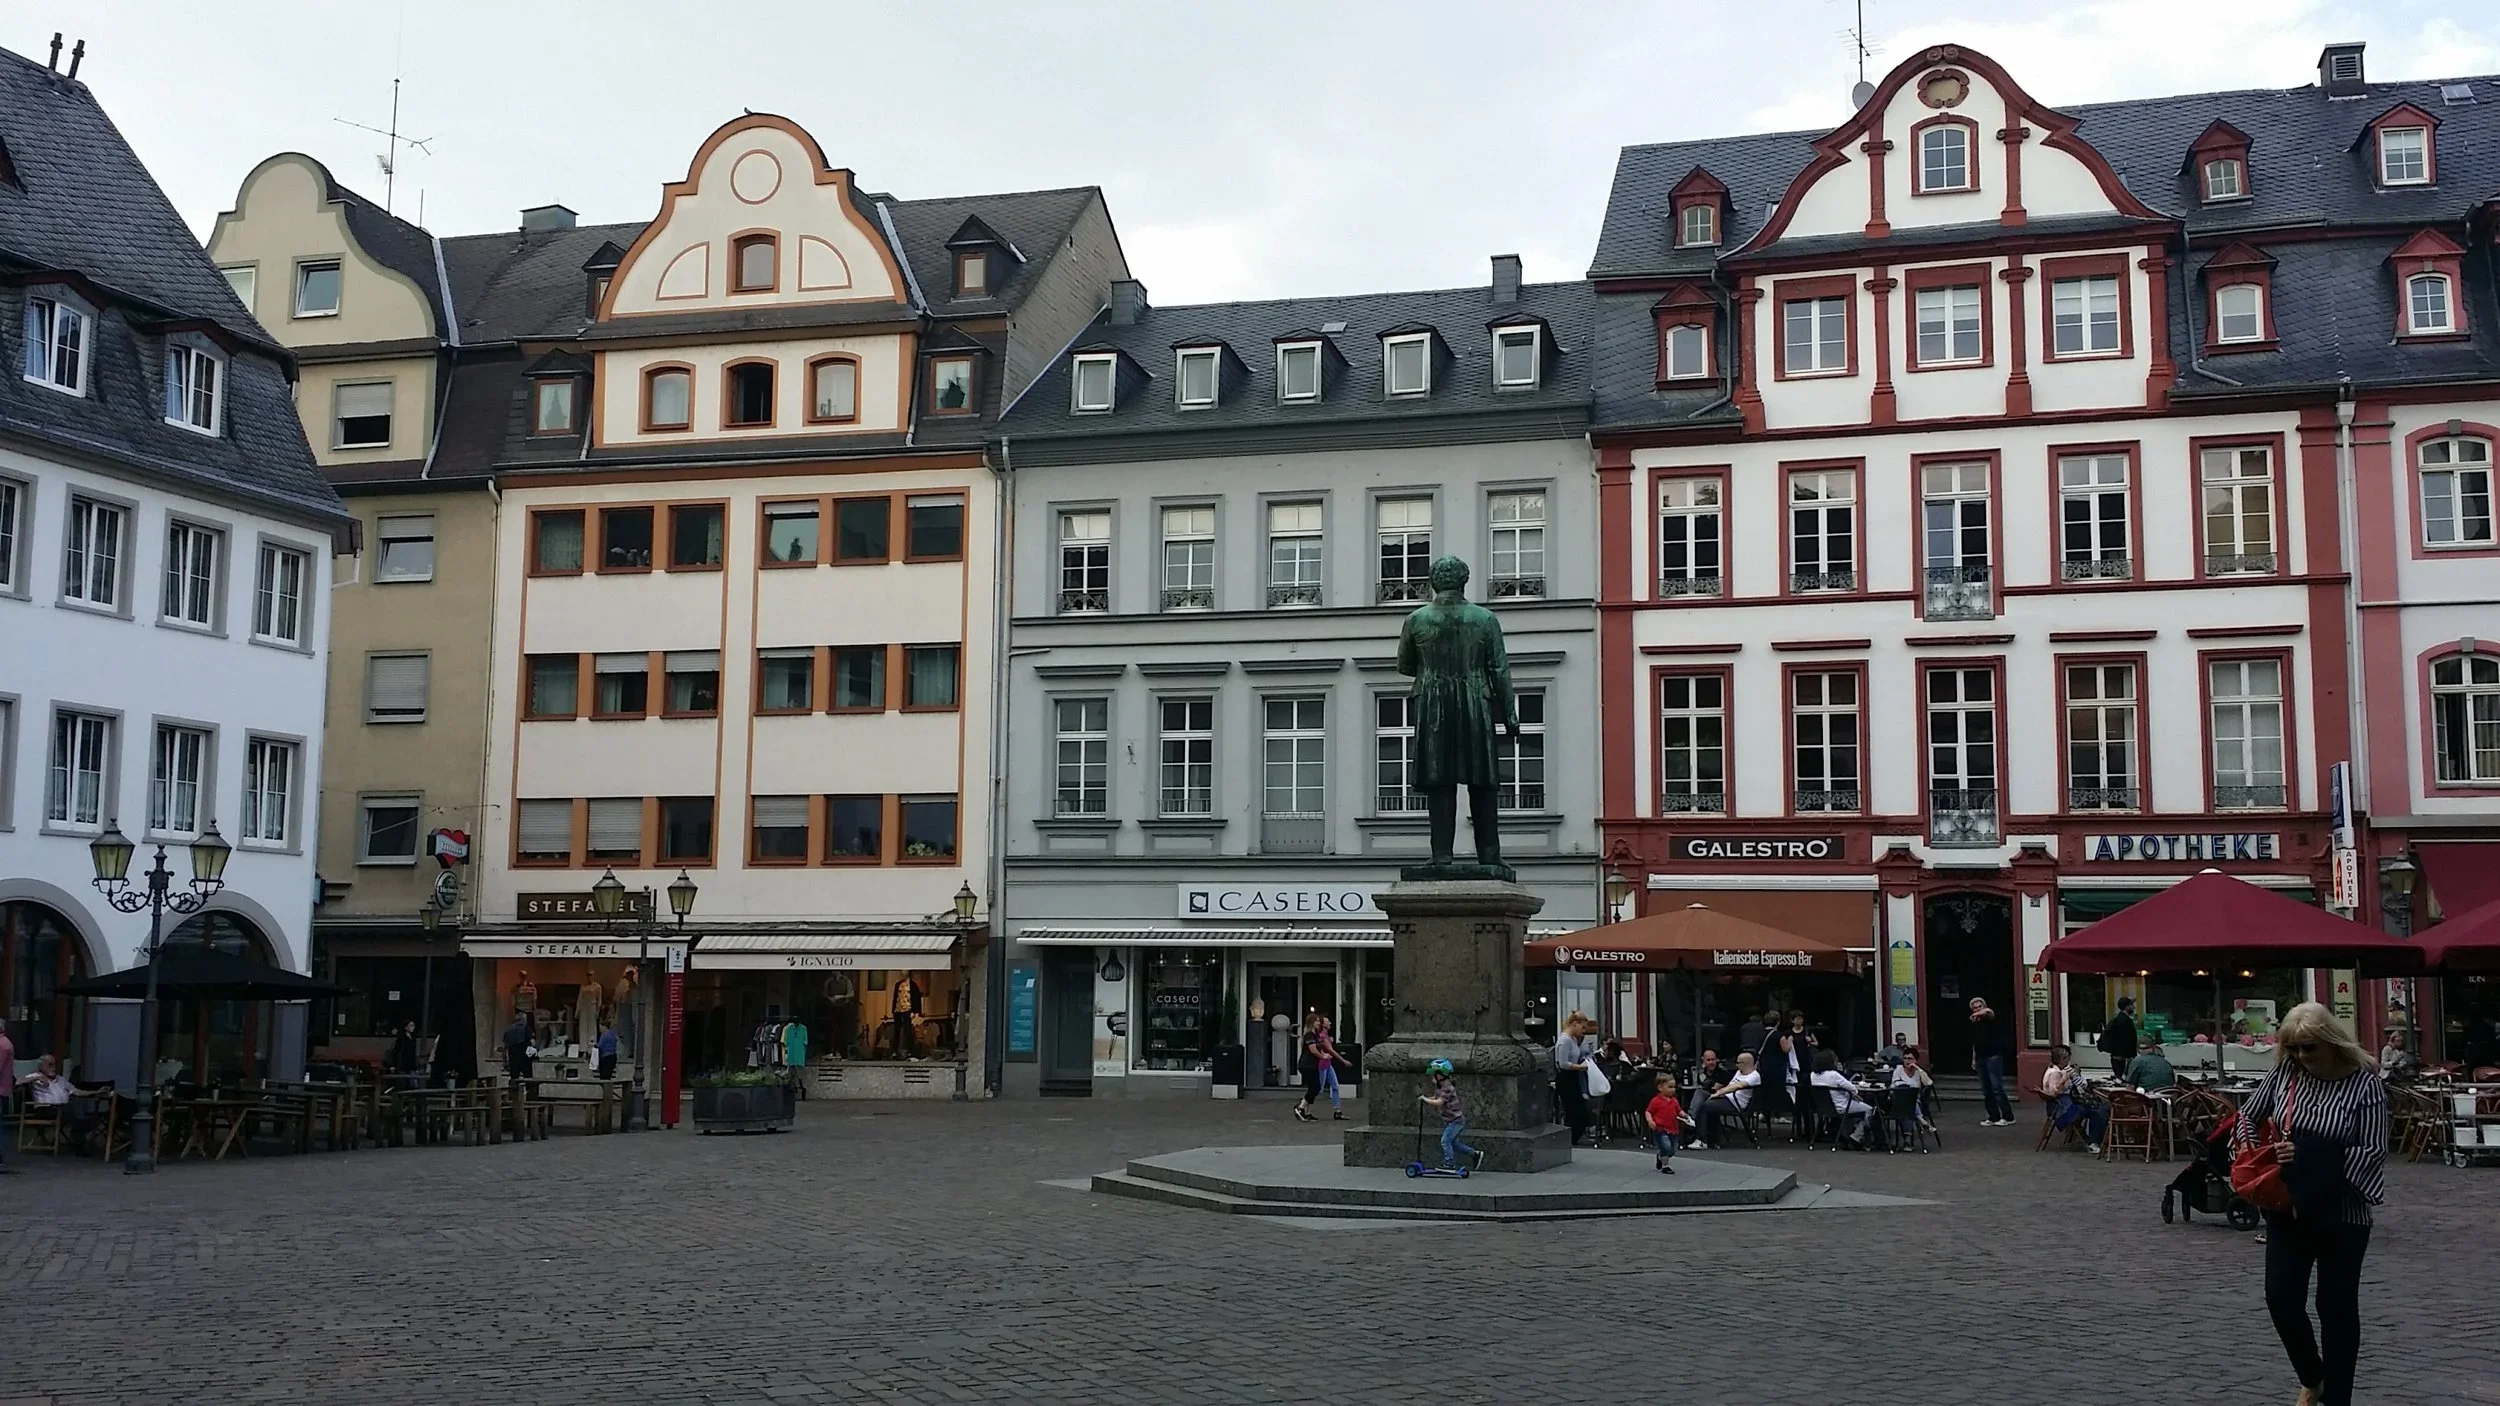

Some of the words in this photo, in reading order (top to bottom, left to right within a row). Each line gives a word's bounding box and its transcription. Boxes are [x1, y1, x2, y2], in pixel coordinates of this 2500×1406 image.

[1687, 839, 1828, 858] GALESTRO
[2095, 834, 2272, 860] APOTHEKE
[2346, 851, 2354, 906] APOTHEKE
[528, 900, 638, 912] STEFAEL
[1219, 891, 1364, 912] CASERO
[525, 944, 619, 955] STEFANEL
[1572, 949, 1646, 962] GALESTRO
[800, 957, 853, 967] IGNACIO
[1713, 950, 1760, 965] Italienische
[1760, 950, 1797, 967] Espresso
[1798, 951, 1812, 966] Bar
[1156, 995, 1199, 1003] casero
